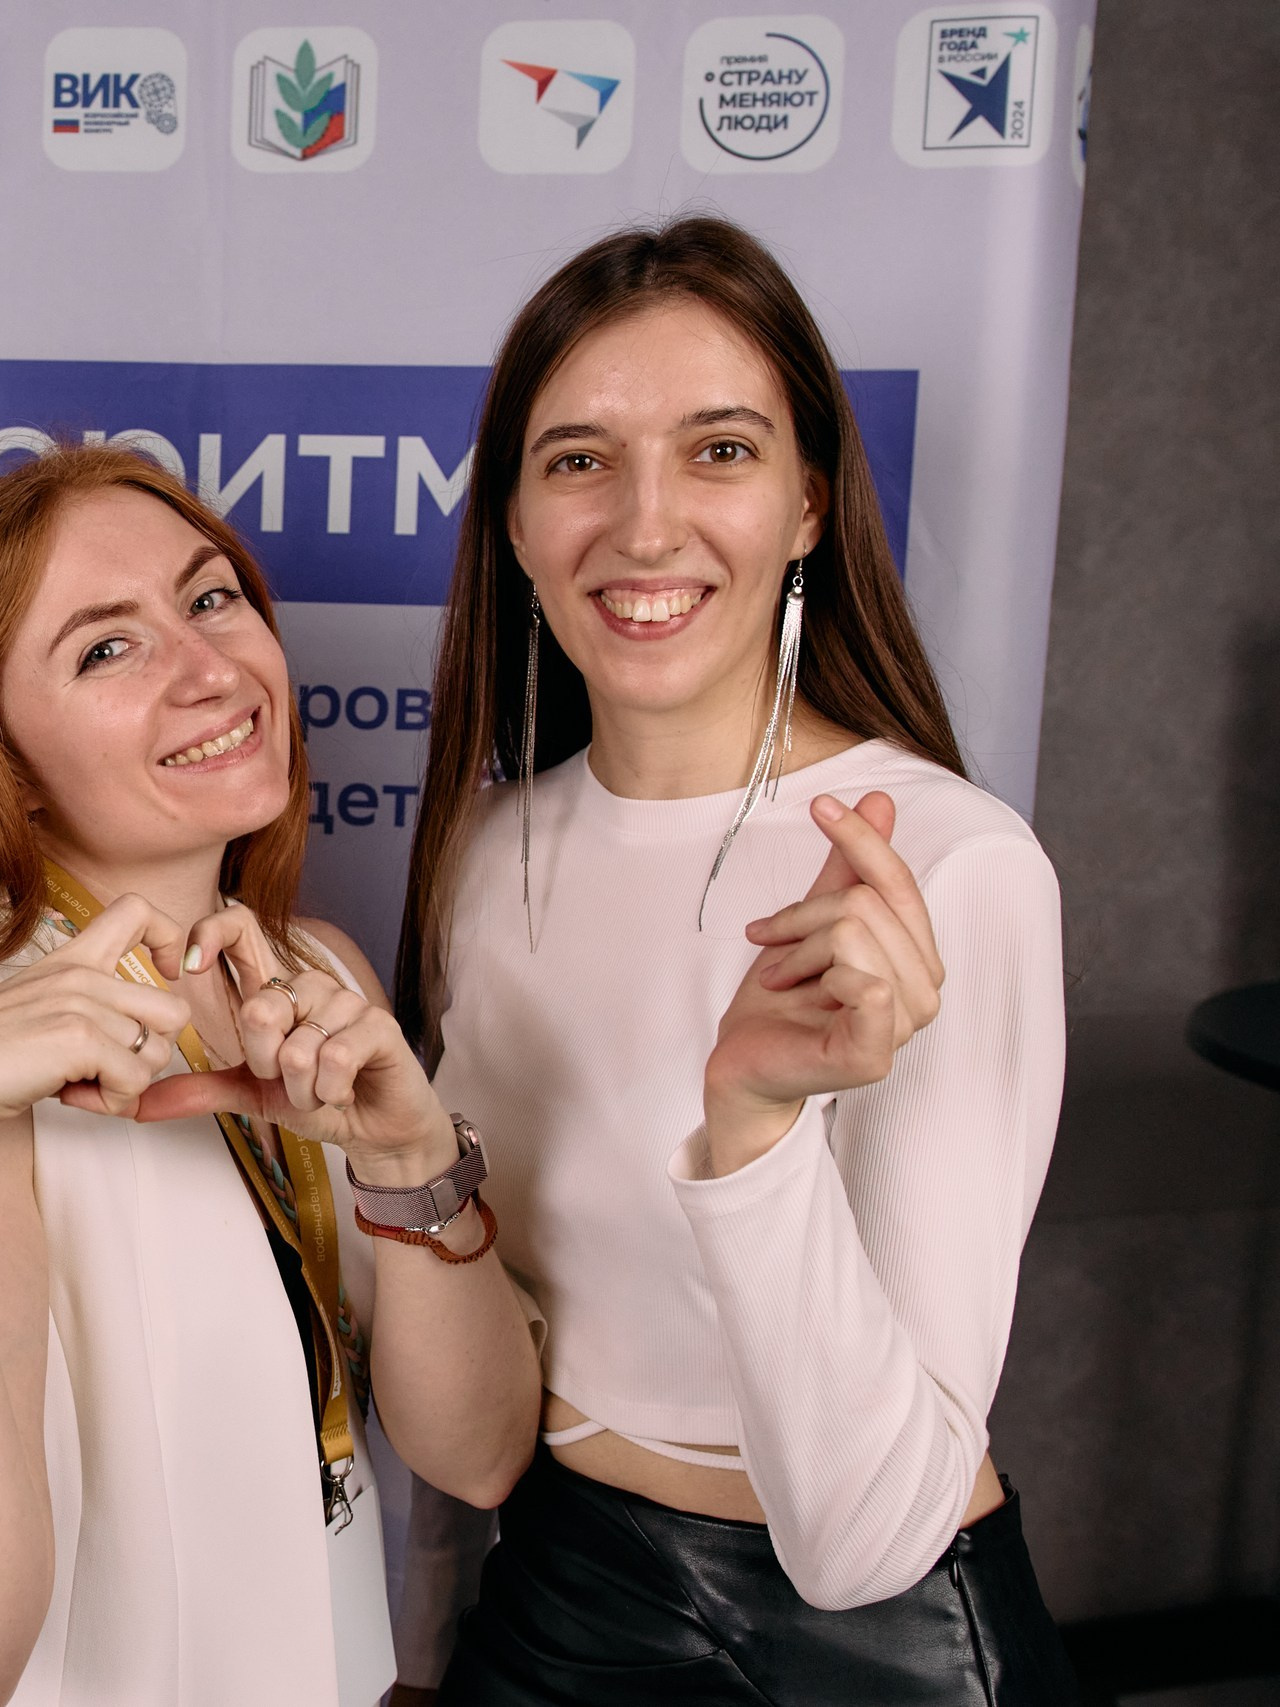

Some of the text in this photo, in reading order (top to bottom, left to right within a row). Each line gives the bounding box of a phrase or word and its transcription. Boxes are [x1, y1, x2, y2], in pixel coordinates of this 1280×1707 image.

[940, 26, 988, 39] БРЕНД
[939, 40, 979, 52] ГОДА
[948, 52, 999, 62] РОССИИ
[719, 68, 809, 87] СТРАНУ
[53, 73, 141, 109] ВИК
[718, 91, 819, 109] МЕНЯЮТ
[717, 114, 788, 133] ЛЮДИ
[1011, 100, 1025, 139] 2024
[300, 1145, 316, 1183] слете
[310, 1186, 326, 1262] партнеров
